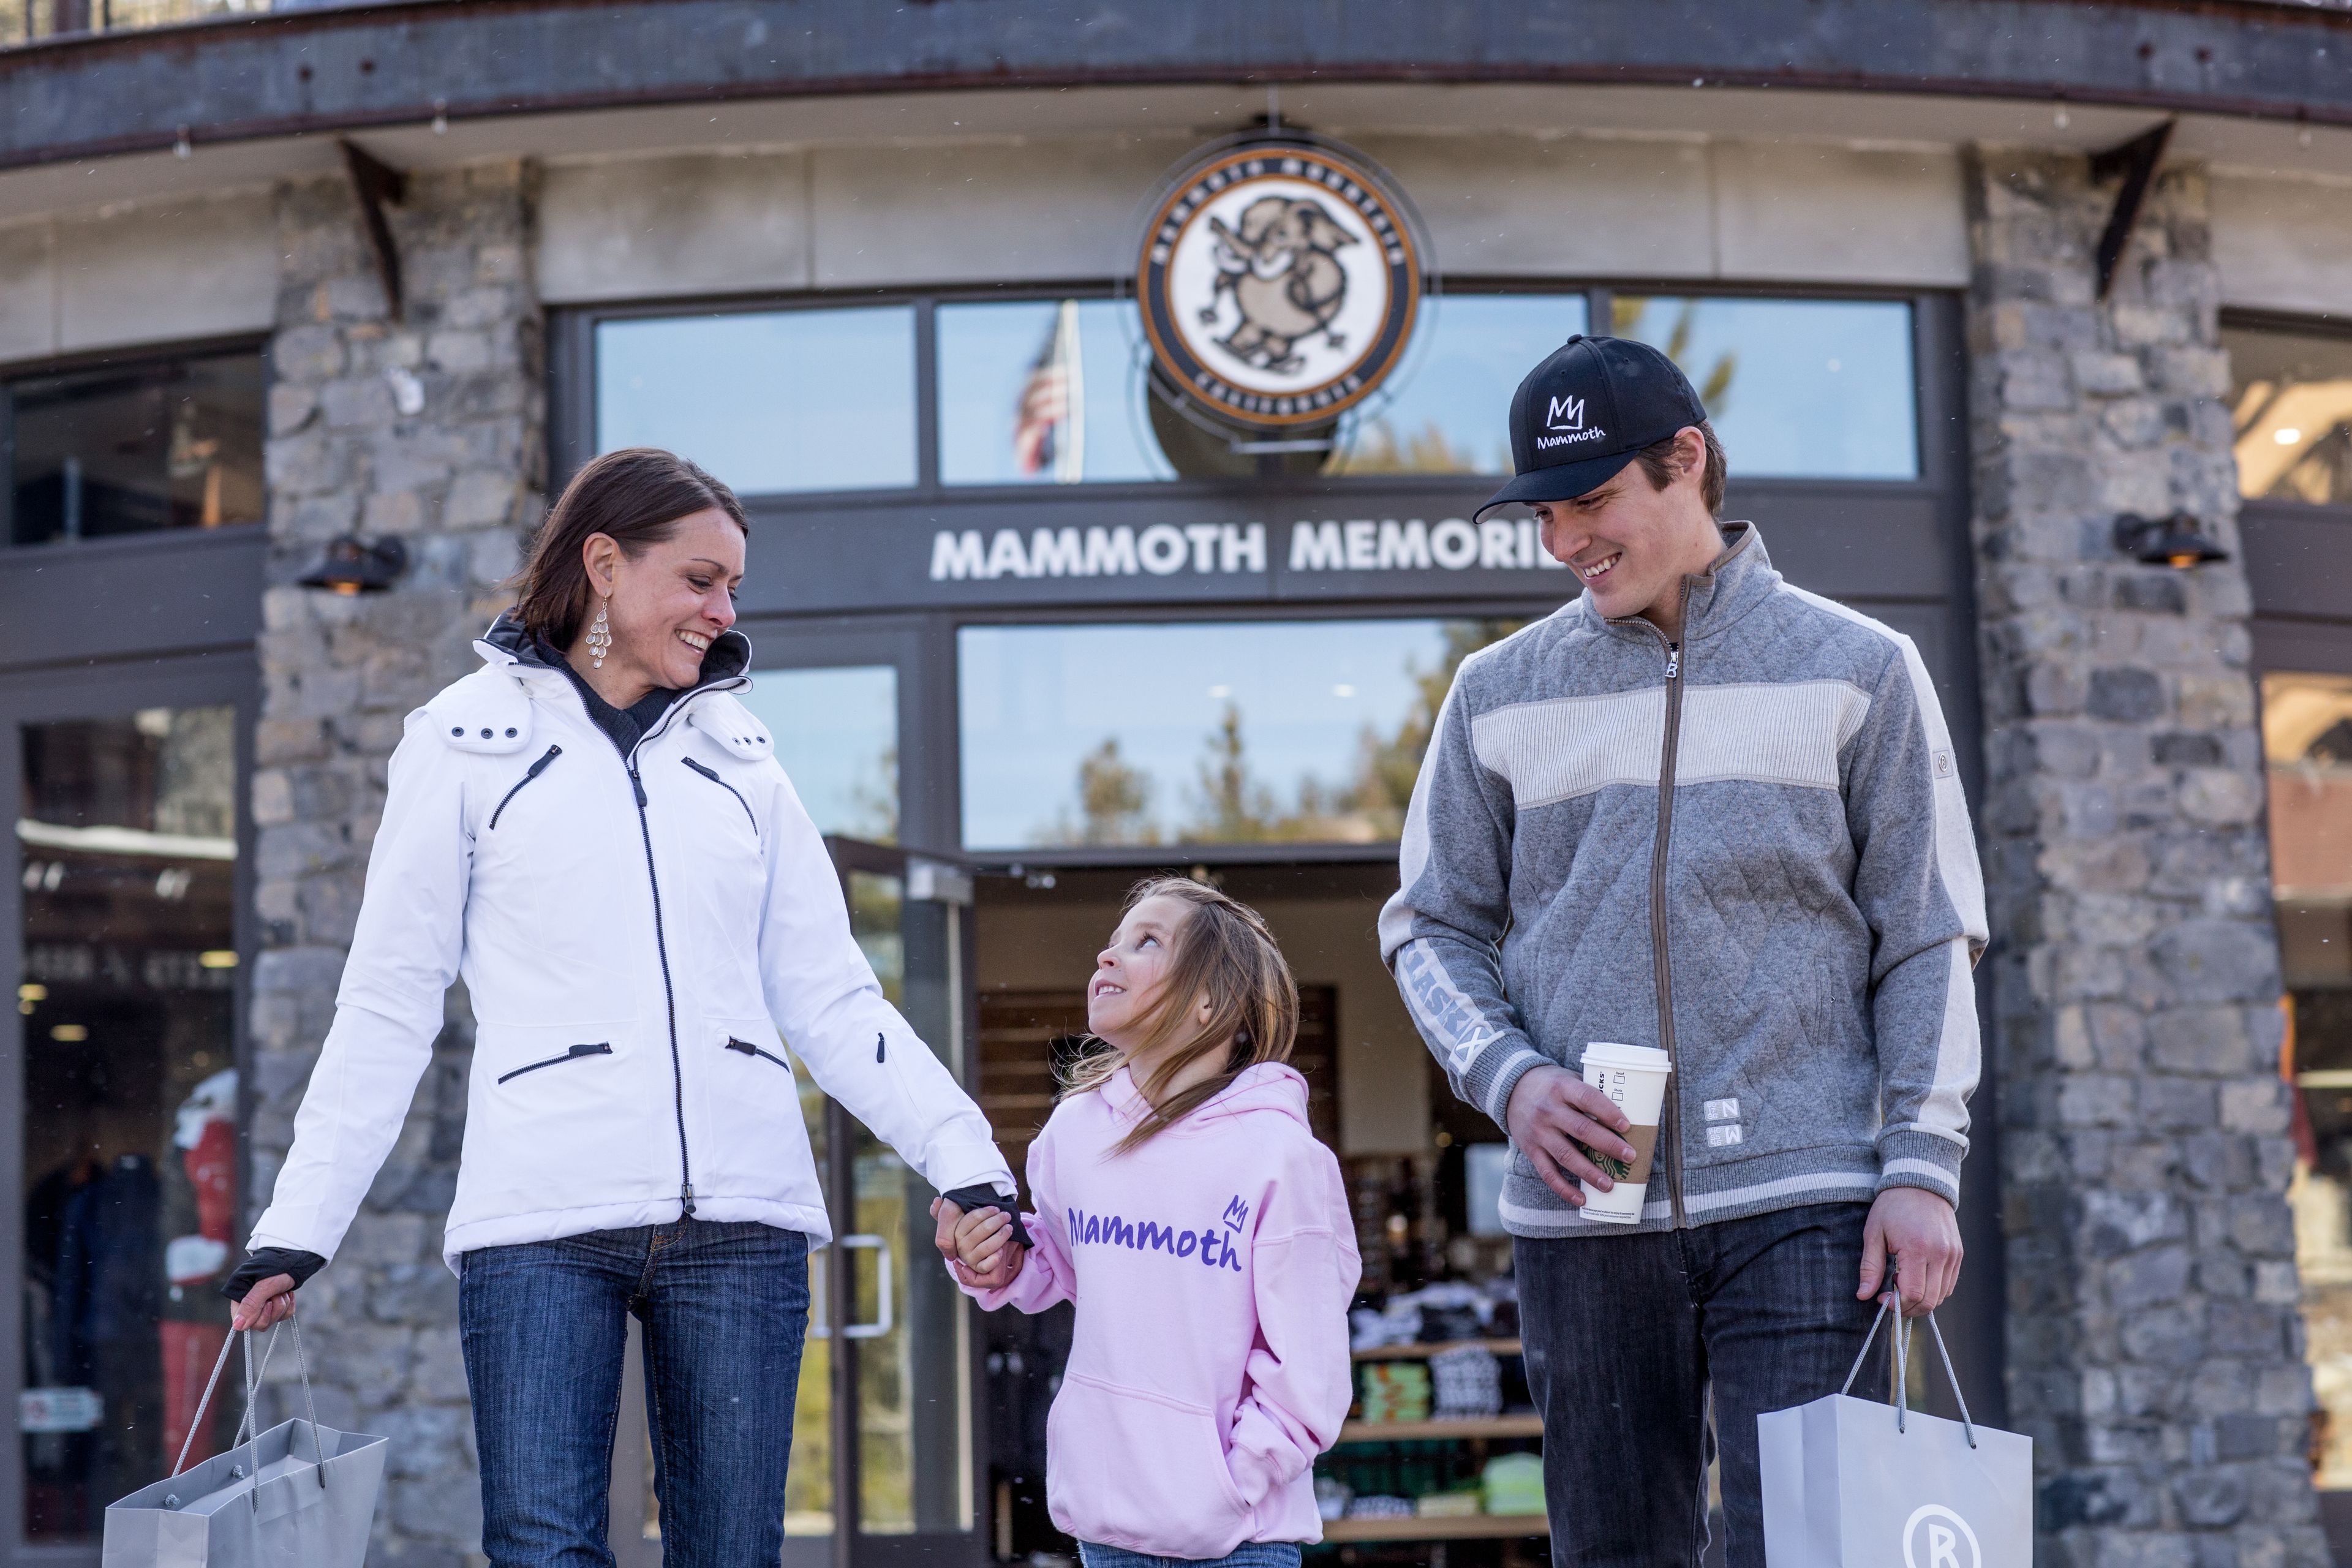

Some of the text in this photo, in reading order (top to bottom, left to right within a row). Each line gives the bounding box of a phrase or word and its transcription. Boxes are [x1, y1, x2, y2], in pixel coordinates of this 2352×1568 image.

[1537, 426, 1606, 450] Mammoth
[929, 523, 1267, 581] MAMMOTH
[1068, 1207, 1242, 1272] Mammoth
